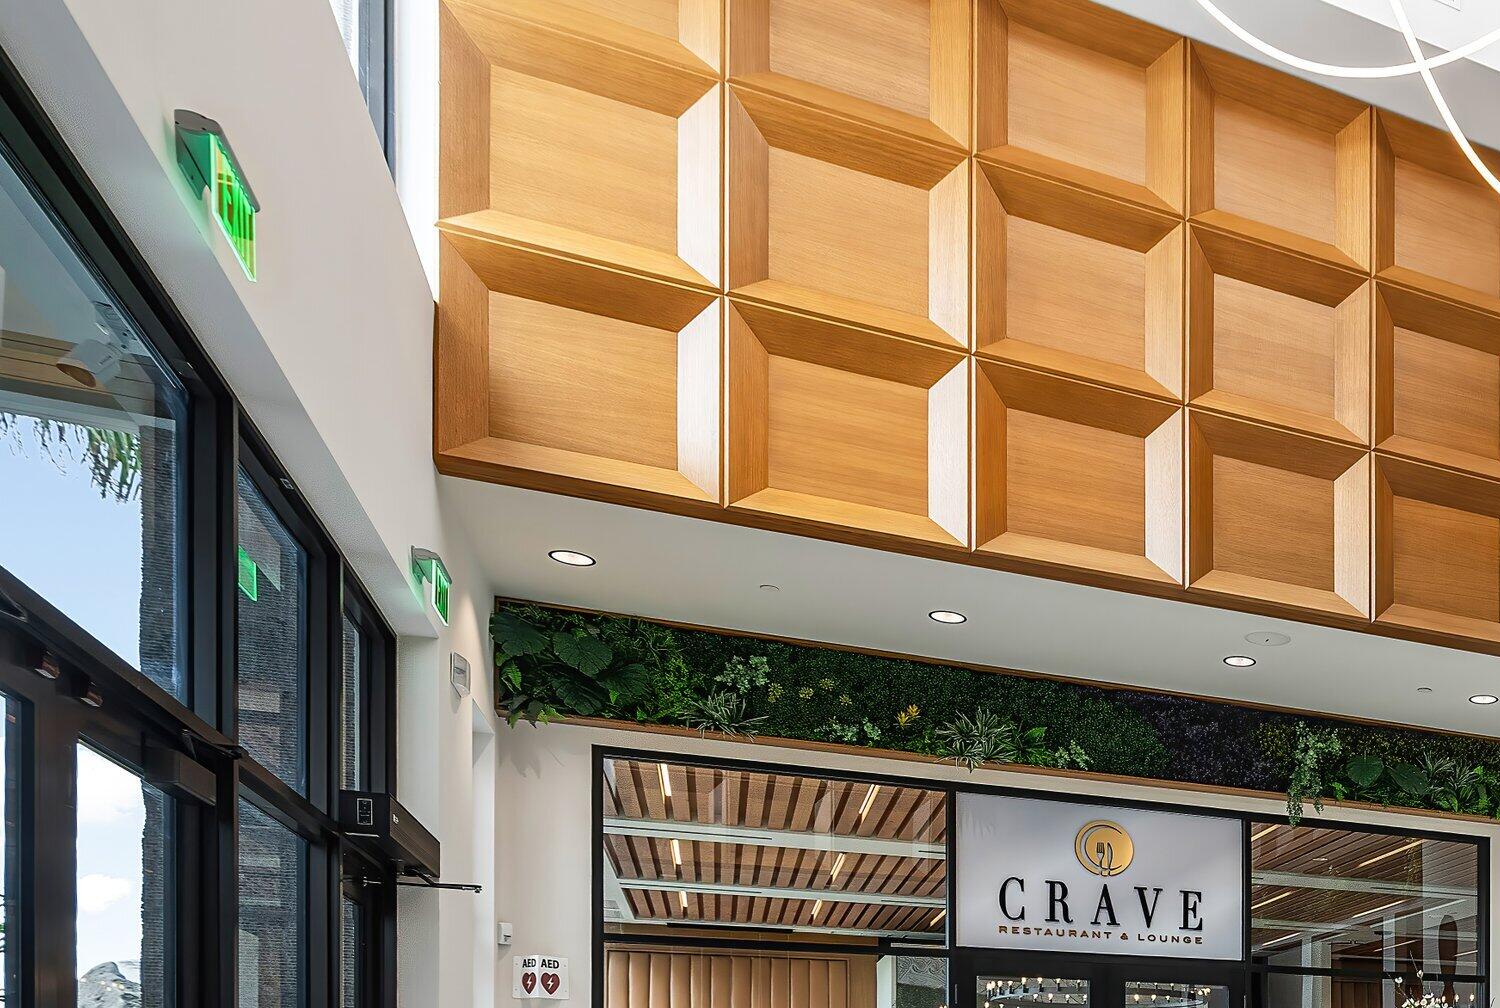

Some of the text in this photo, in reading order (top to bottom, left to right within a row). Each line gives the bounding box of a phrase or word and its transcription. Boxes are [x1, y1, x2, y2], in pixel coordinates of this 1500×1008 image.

[999, 876, 1203, 931] CRAVE
[998, 925, 1203, 944] RESTAURANT & LOUNGE
[522, 958, 536, 968] AED
[541, 959, 560, 969] AED
